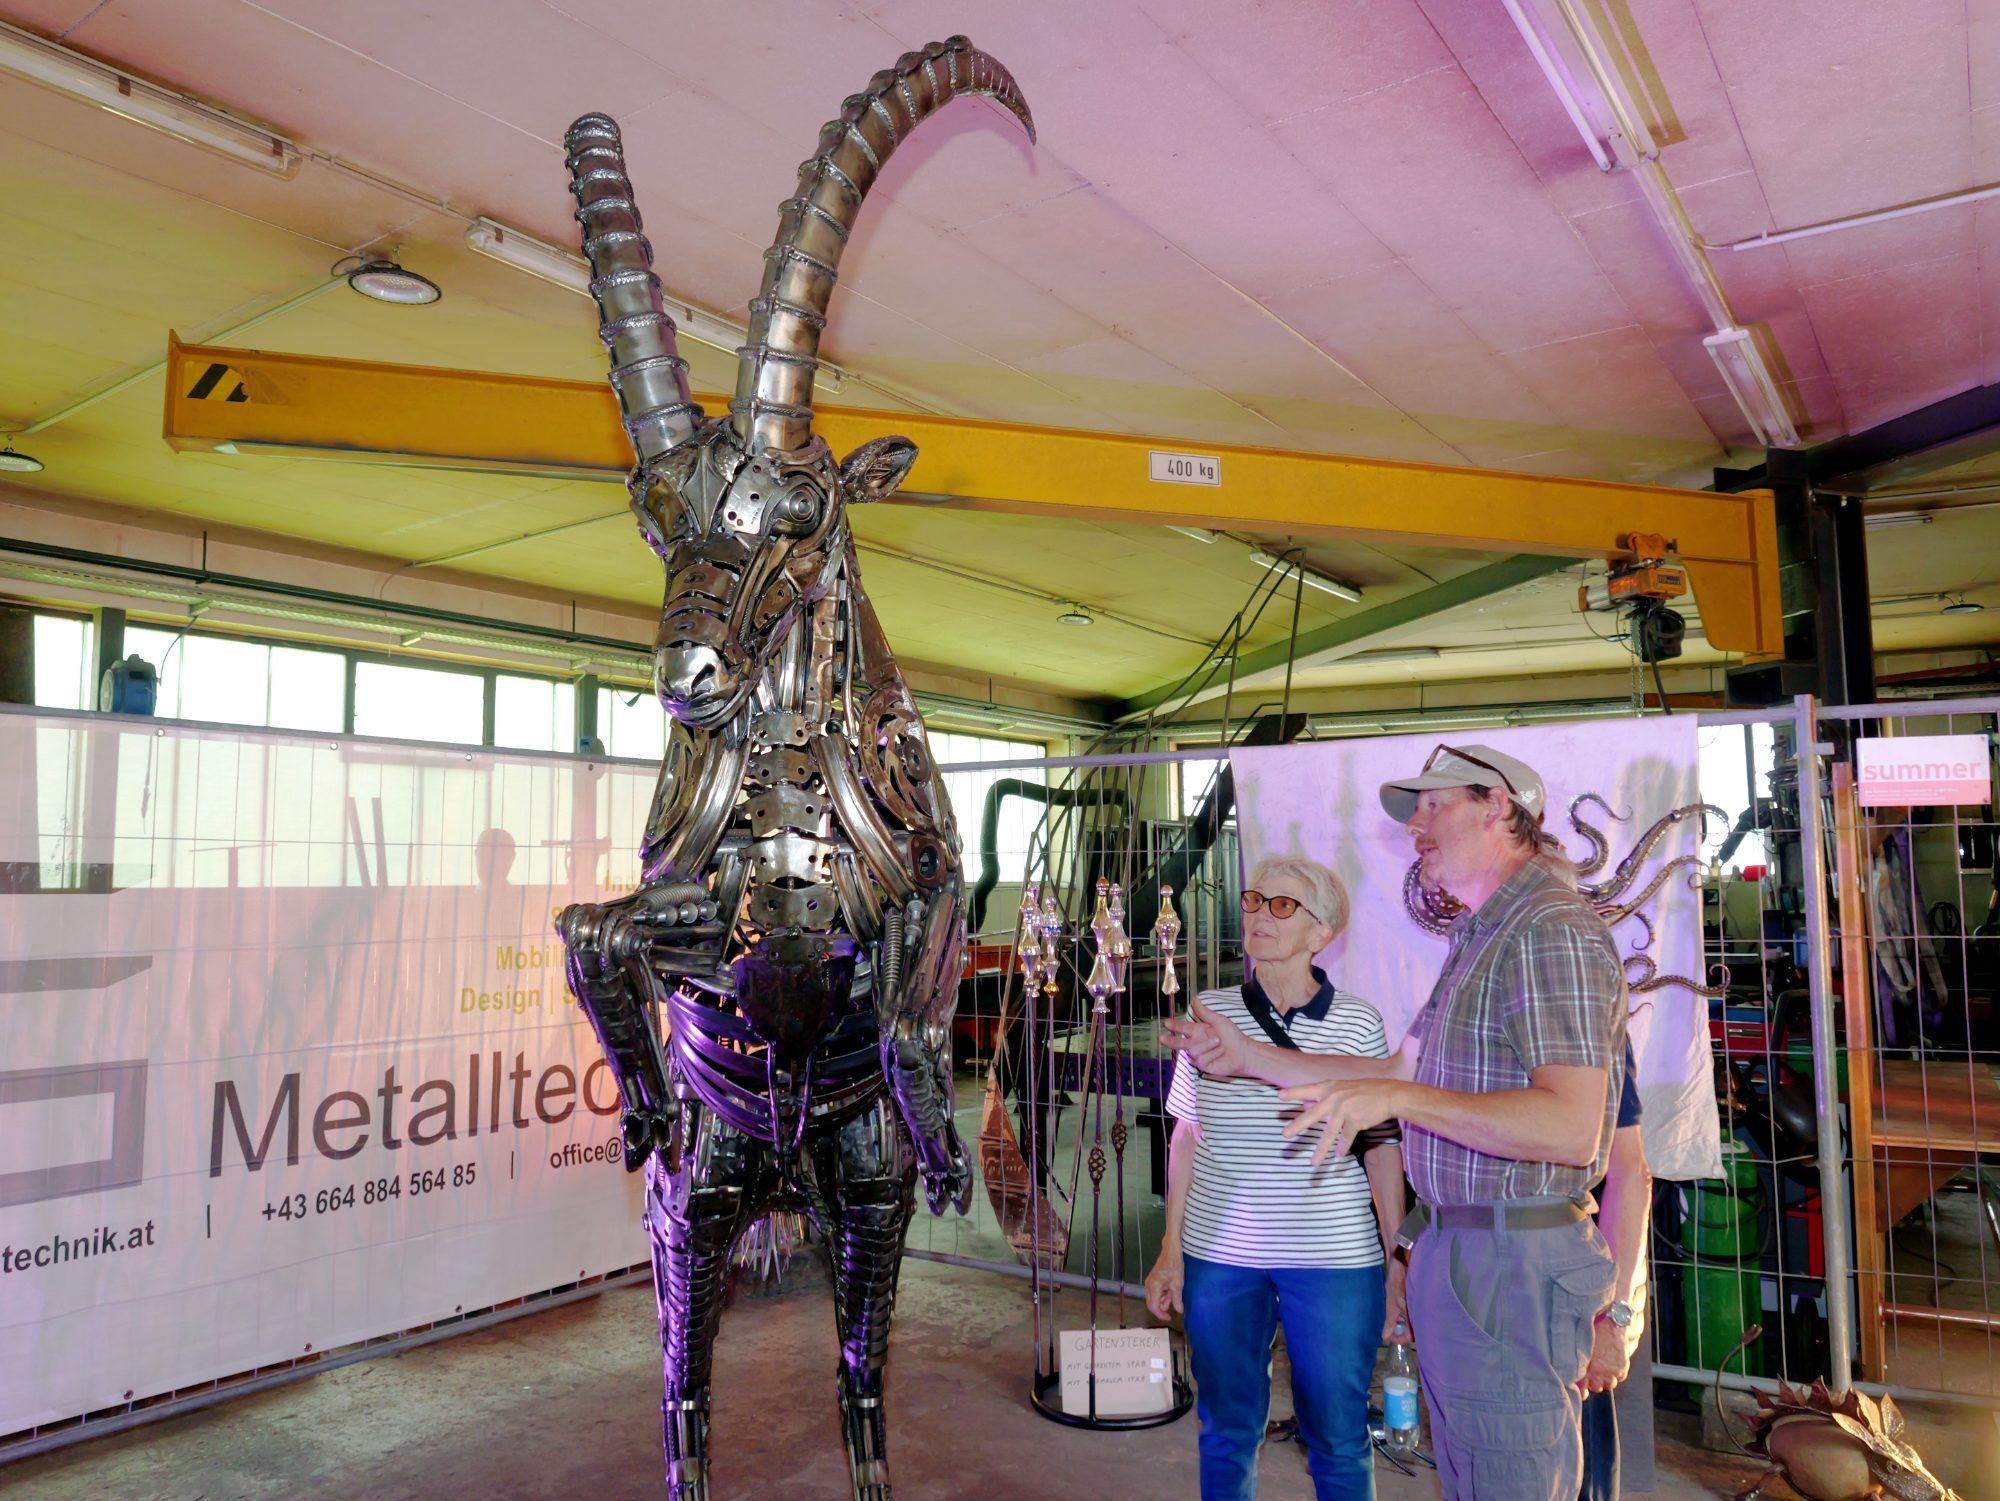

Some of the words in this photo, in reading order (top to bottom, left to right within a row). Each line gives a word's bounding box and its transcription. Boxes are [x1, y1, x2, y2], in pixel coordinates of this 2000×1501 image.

[1168, 460, 1192, 477] 400
[1200, 463, 1214, 480] kg
[1864, 762, 1981, 780] summer
[461, 985, 540, 1015] Design
[209, 1050, 621, 1177] Metalltec
[2, 1219, 155, 1273] technik.at
[262, 1193, 306, 1222] +43
[316, 1184, 355, 1215] 664
[364, 1176, 401, 1205] 884
[410, 1167, 446, 1197] 564
[454, 1162, 476, 1188] 85
[550, 1137, 622, 1168] office@
